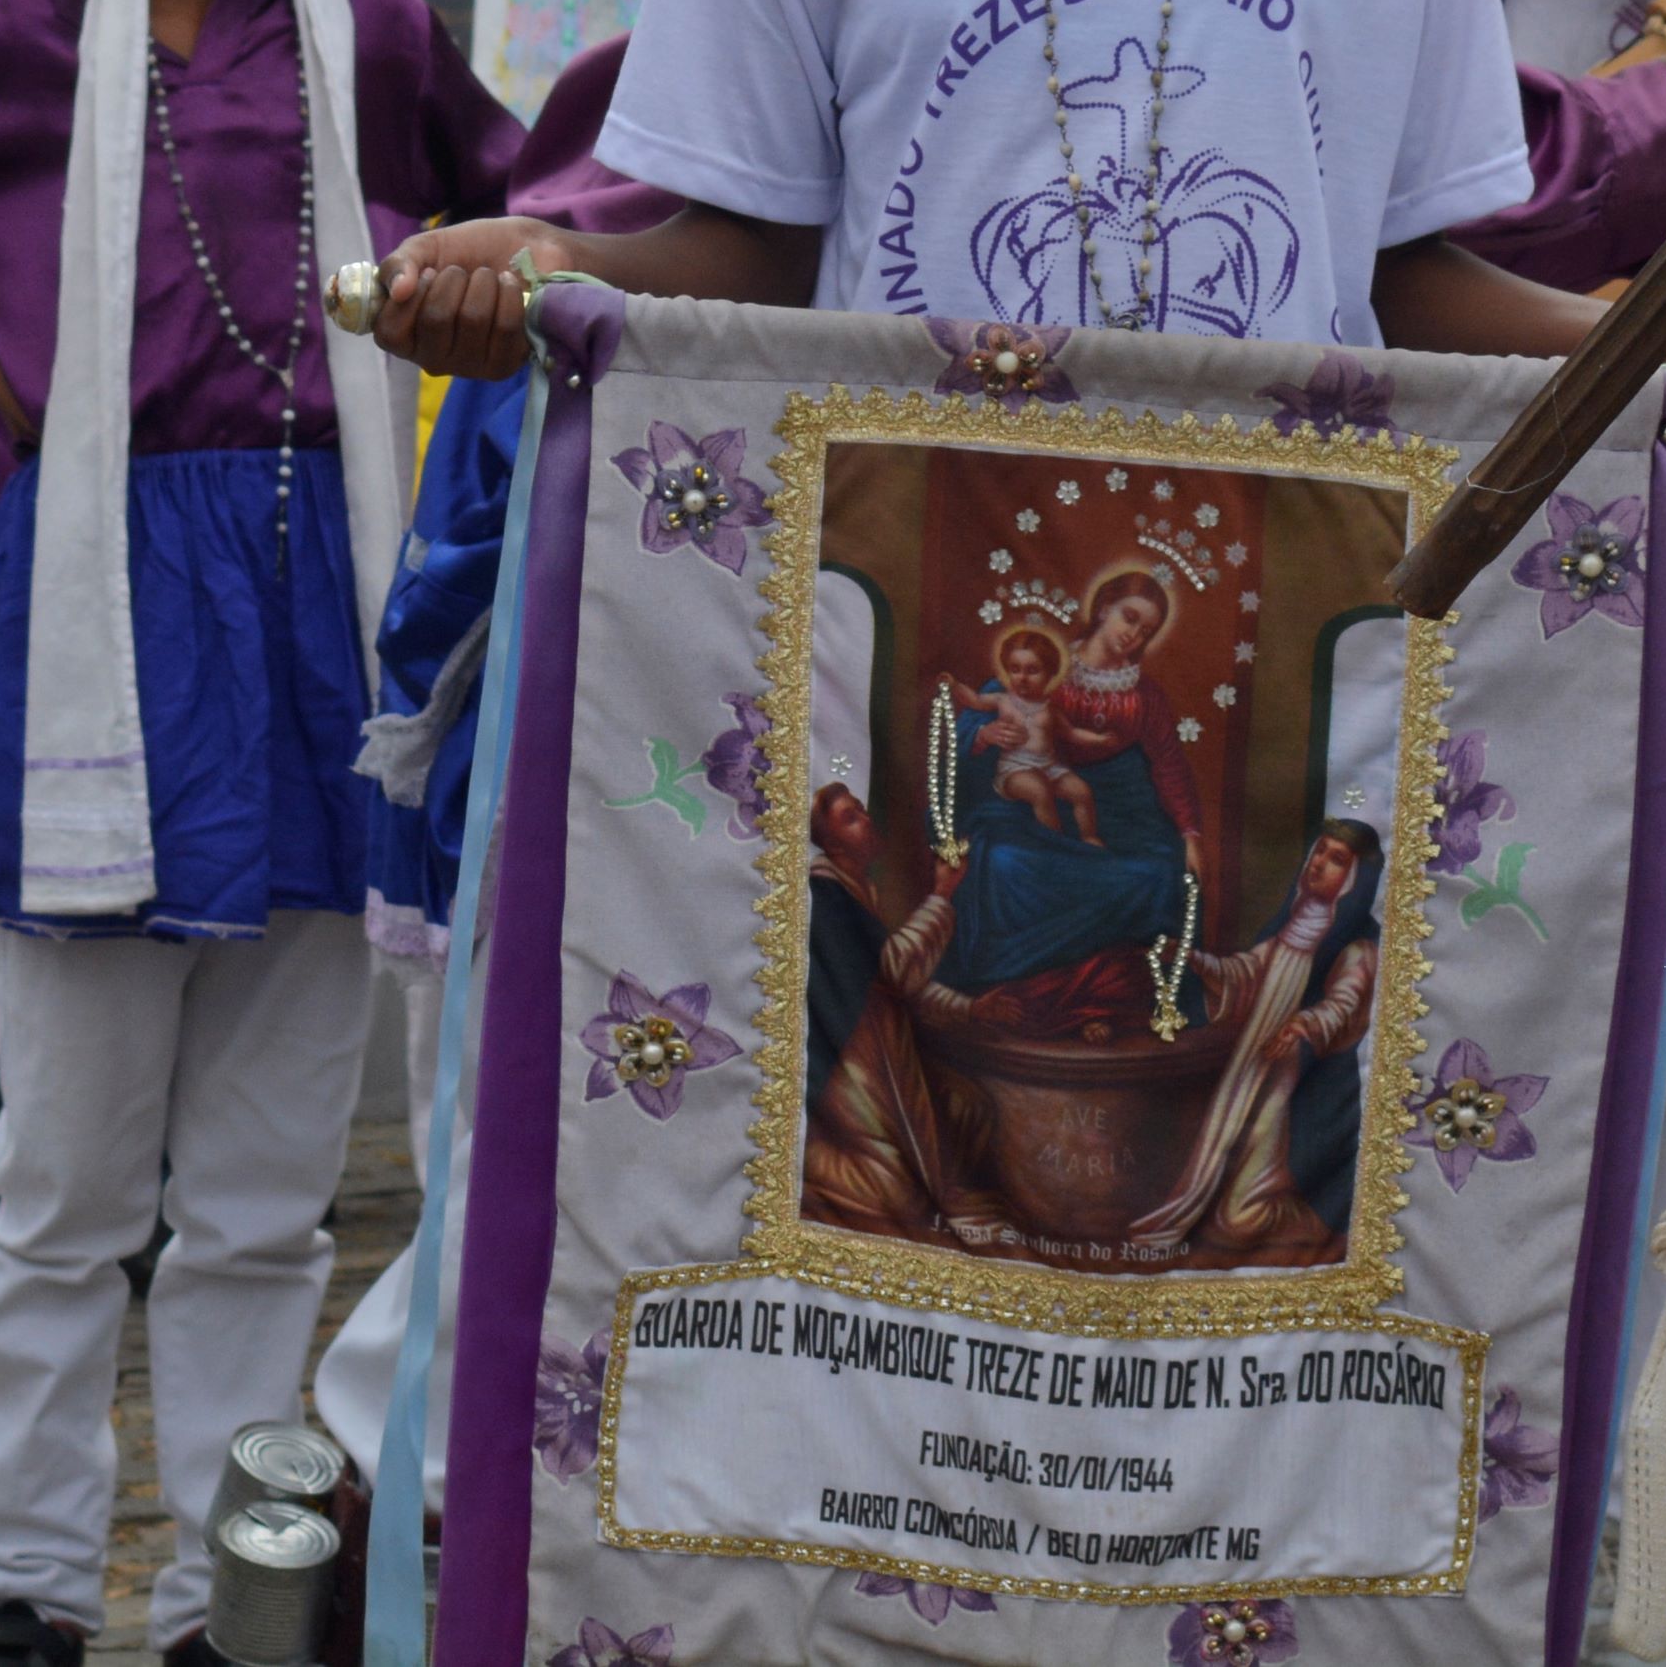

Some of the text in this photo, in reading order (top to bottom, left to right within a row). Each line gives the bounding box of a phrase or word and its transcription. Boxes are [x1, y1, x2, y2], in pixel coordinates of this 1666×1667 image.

[1062, 1108, 1109, 1130] AVE
[1037, 1143, 1137, 1177] MARIA
[1089, 1242, 1111, 1262] do
[635, 1298, 1446, 1411] GUARDA DE MOÇAMBIQUE TREZE DE MAIO DE N. Sra. DO ROSÁRIO
[920, 1430, 1174, 1493] FUNDAÇÃO: 30/01/1944
[819, 1488, 899, 1531] BAIRRO
[904, 1499, 1019, 1555] CONCÓRDIA
[1047, 1527, 1101, 1565] BELO
[1106, 1525, 1220, 1566] HORIZONTE
[1225, 1527, 1261, 1562] MG
